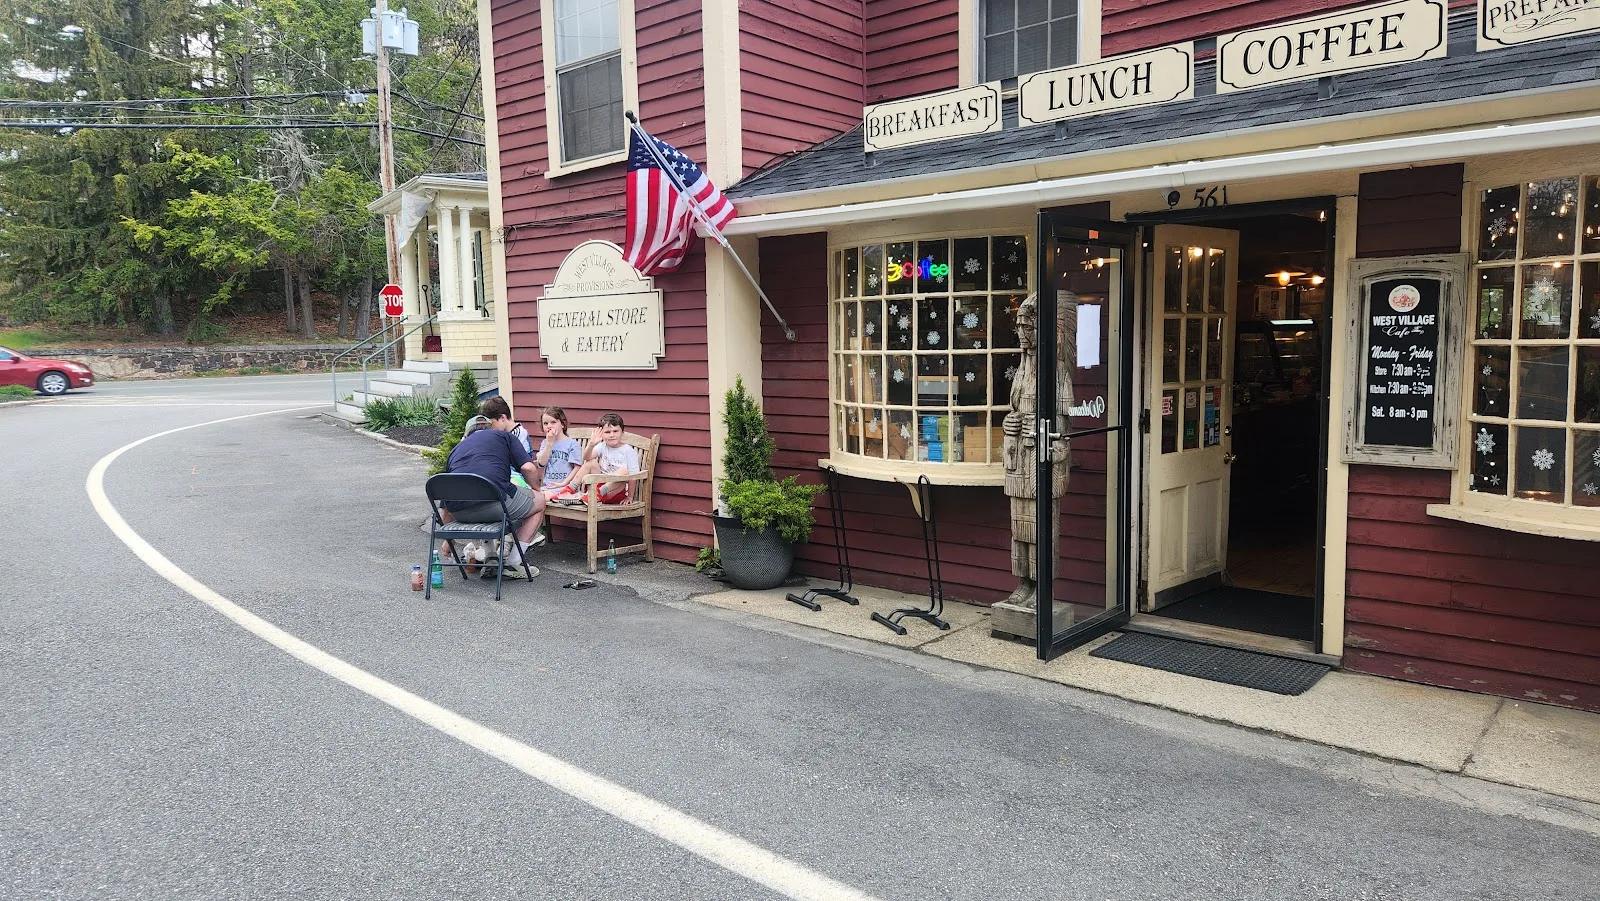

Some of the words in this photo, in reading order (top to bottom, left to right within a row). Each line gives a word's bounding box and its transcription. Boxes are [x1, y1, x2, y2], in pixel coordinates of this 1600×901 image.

[1242, 12, 1406, 75] COFFEE
[1049, 61, 1153, 111] LUNCH
[869, 95, 993, 138] BREAKFAST
[1193, 185, 1228, 208] 561
[574, 256, 589, 279] WEST
[590, 253, 616, 277] VILLAGE
[576, 280, 614, 292] PROVISIONS
[548, 310, 603, 329] GENERAL
[606, 307, 648, 326] STORE
[1373, 315, 1397, 326] WEST
[1398, 314, 1435, 326] VILLAGE
[561, 337, 569, 353] &
[577, 332, 629, 352] EATERY
[1371, 345, 1400, 362] Monday
[1408, 345, 1434, 362] Friday
[1374, 365, 1388, 376] Store
[1391, 363, 1404, 376] 7:30
[1404, 366, 1413, 376] am
[1369, 384, 1386, 394] Kitchen
[1387, 381, 1400, 394] 7:30
[1400, 384, 1409, 394] am
[1371, 405, 1385, 417] Sat.
[1389, 406, 1395, 418] 8
[1395, 408, 1406, 418] am
[1410, 407, 1416, 418] 3
[1416, 409, 1428, 421] pm
